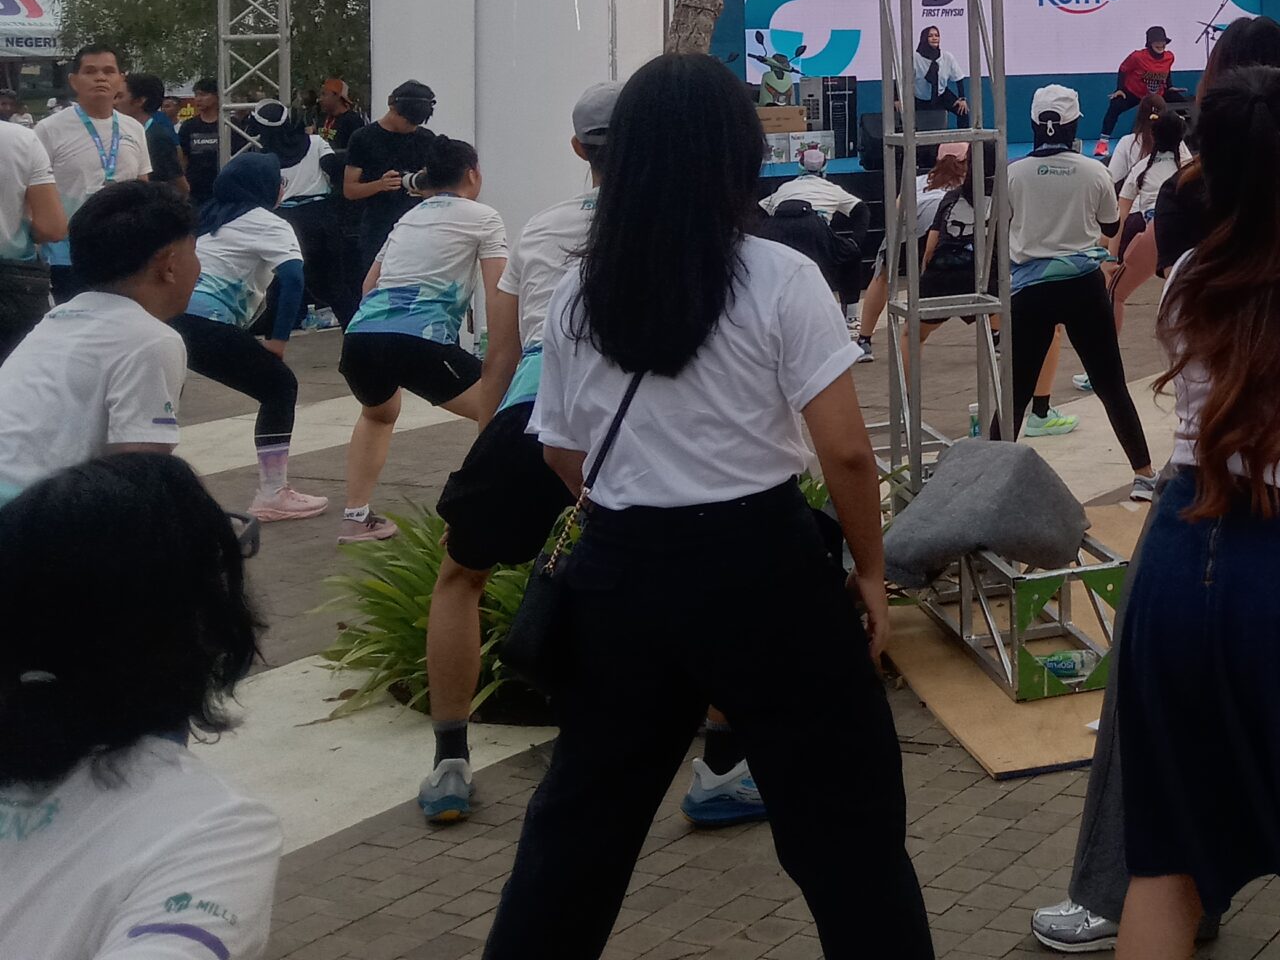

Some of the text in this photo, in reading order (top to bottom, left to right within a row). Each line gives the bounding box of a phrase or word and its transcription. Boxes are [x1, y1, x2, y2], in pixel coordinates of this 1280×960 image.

[922, 8, 964, 17] FIRST PHYSIO
[196, 899, 238, 926] MILLS
